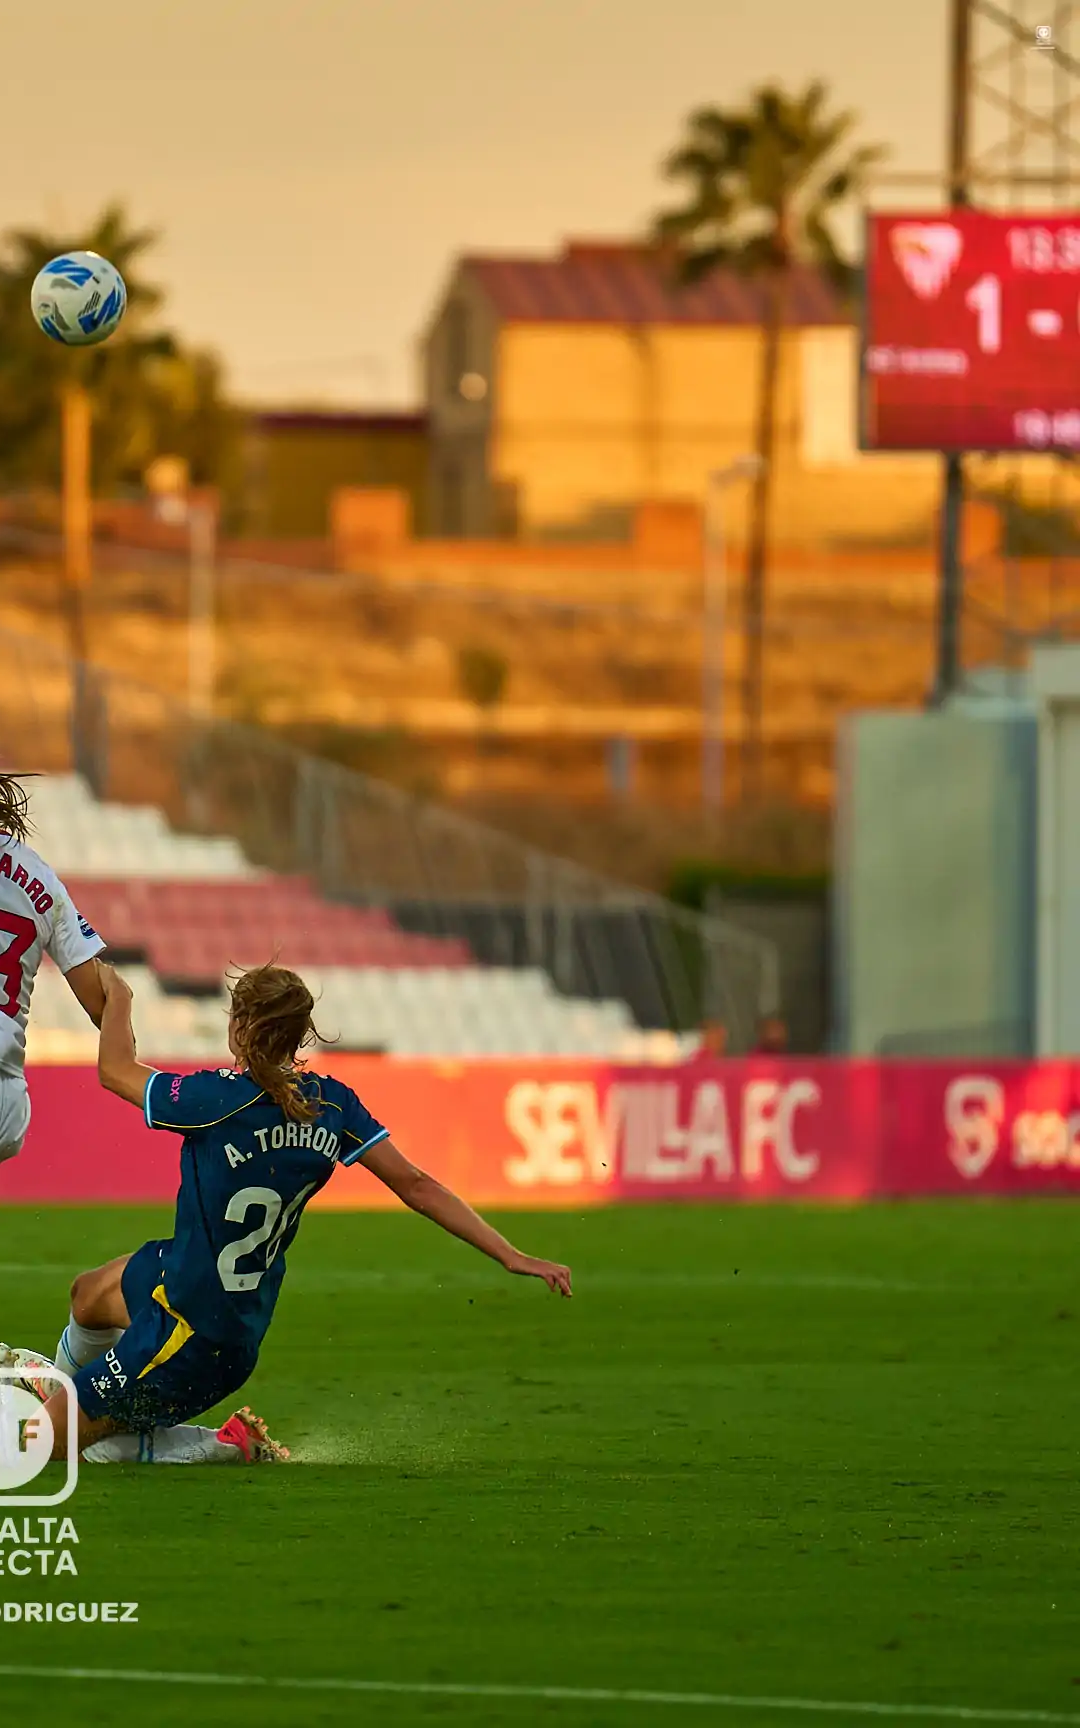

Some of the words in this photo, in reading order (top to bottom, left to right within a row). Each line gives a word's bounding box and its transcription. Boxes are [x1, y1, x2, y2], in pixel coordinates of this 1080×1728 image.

[966, 274, 1001, 353] 1
[224, 1143, 253, 1169] A.
[503, 1080, 734, 1184] SEVILLA
[742, 1079, 820, 1182] FC
[90, 1376, 106, 1399] KELME
